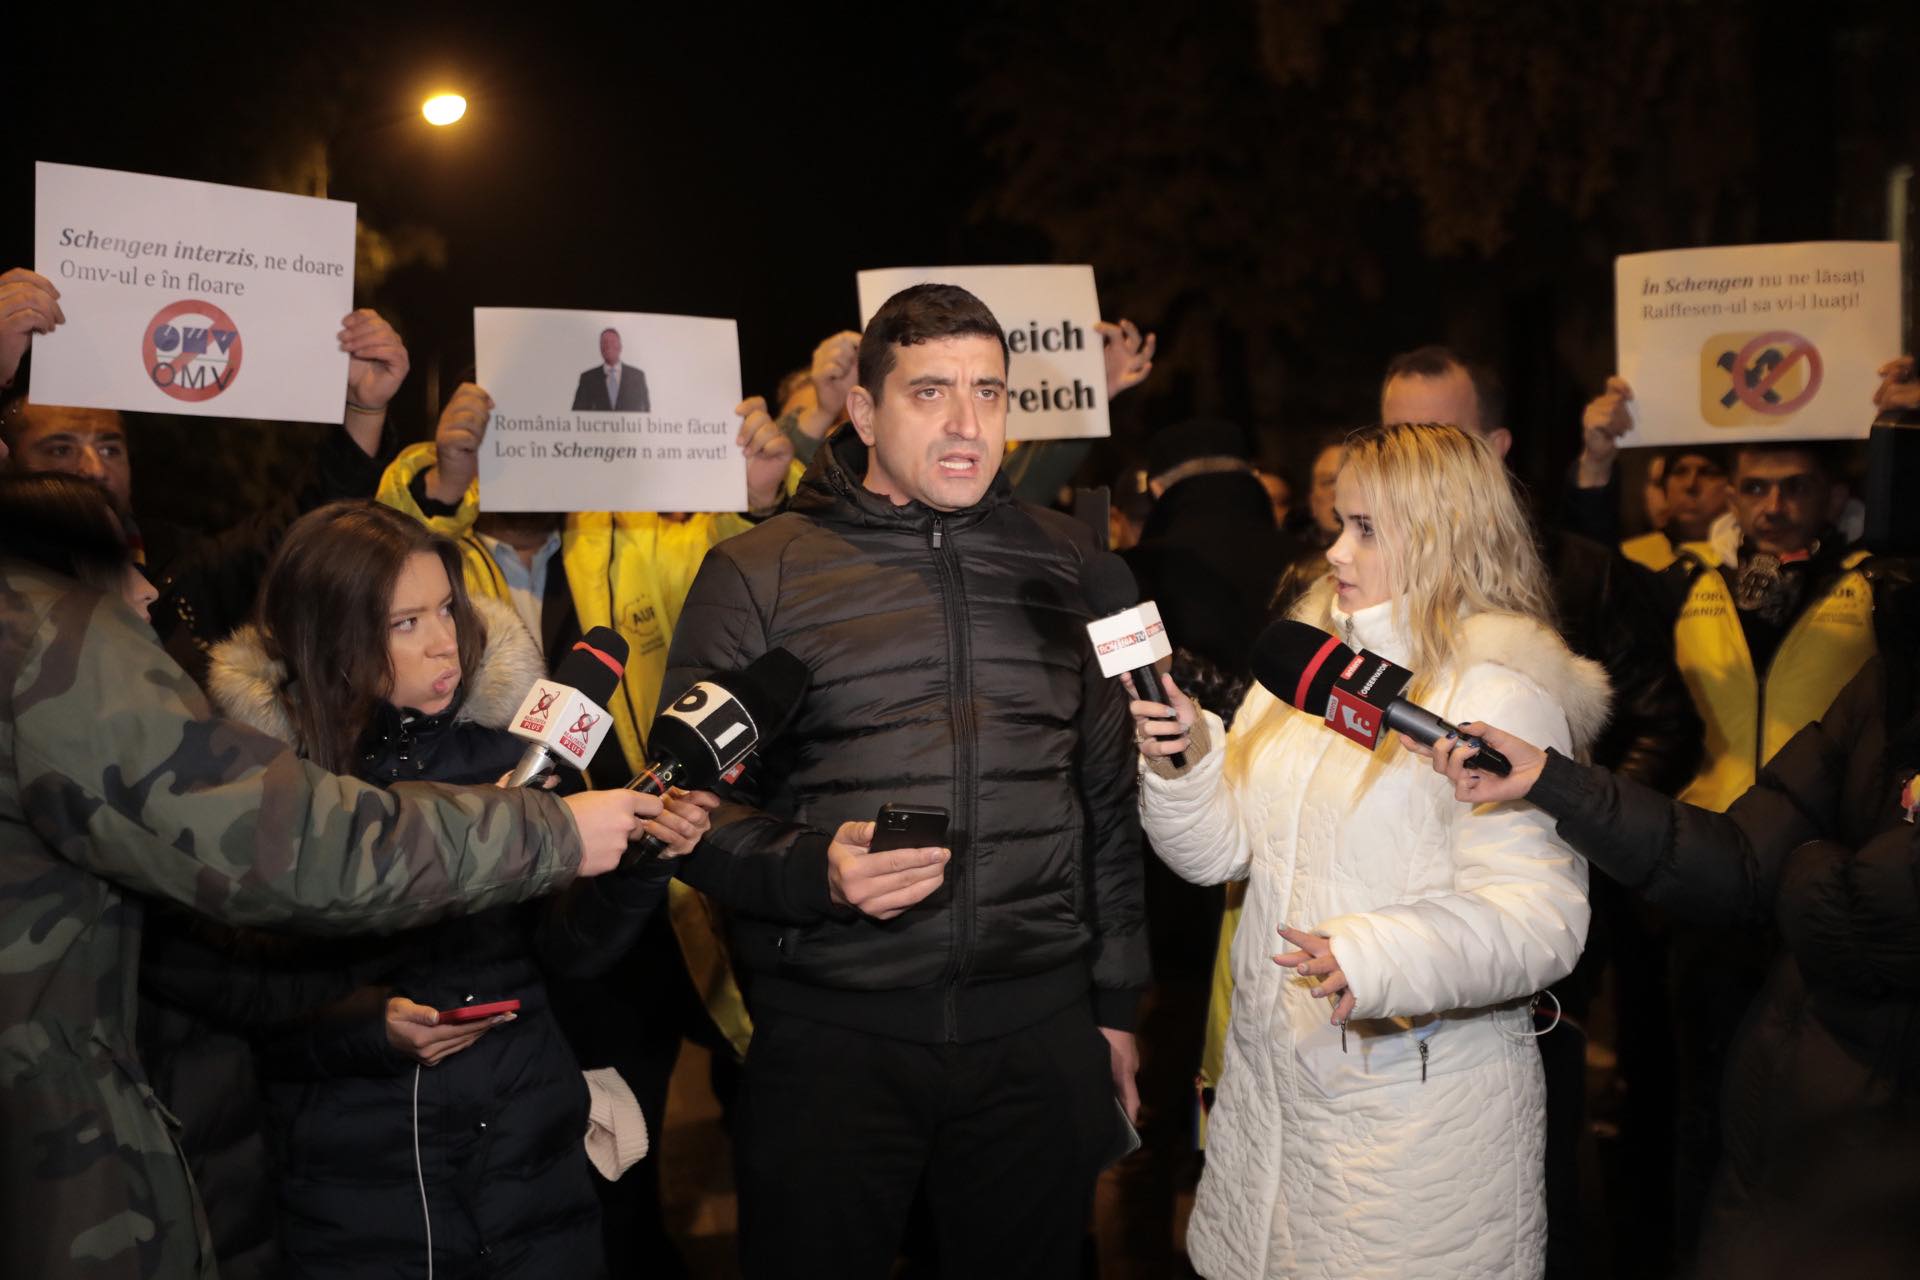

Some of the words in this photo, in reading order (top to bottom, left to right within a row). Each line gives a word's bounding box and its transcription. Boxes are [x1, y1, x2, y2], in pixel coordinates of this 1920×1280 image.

[60, 227, 167, 258] Schengen
[174, 241, 258, 269] interzis,
[264, 254, 287, 270] ne
[293, 255, 344, 277] doare
[60, 260, 138, 286] Omv-ul
[144, 274, 156, 286] e
[162, 270, 180, 289] în
[187, 273, 245, 296] floare
[1664, 274, 1754, 294] Schengen
[1759, 274, 1782, 287] nu
[1788, 272, 1810, 285] ne
[1005, 320, 1084, 353] eich
[152, 362, 234, 391] OMV
[494, 414, 571, 432] România
[576, 416, 642, 434] lucrului
[647, 417, 683, 434] bine
[687, 418, 728, 435] făcut
[495, 441, 526, 458] Loc
[530, 442, 548, 458] în
[551, 442, 638, 463] Schengen
[641, 446, 652, 458] n
[656, 446, 682, 459] am
[686, 444, 728, 460] avut!
[1360, 662, 1389, 695] OBSERVATOR
[524, 722, 541, 730] PLUS
[564, 739, 581, 754] PLUS
